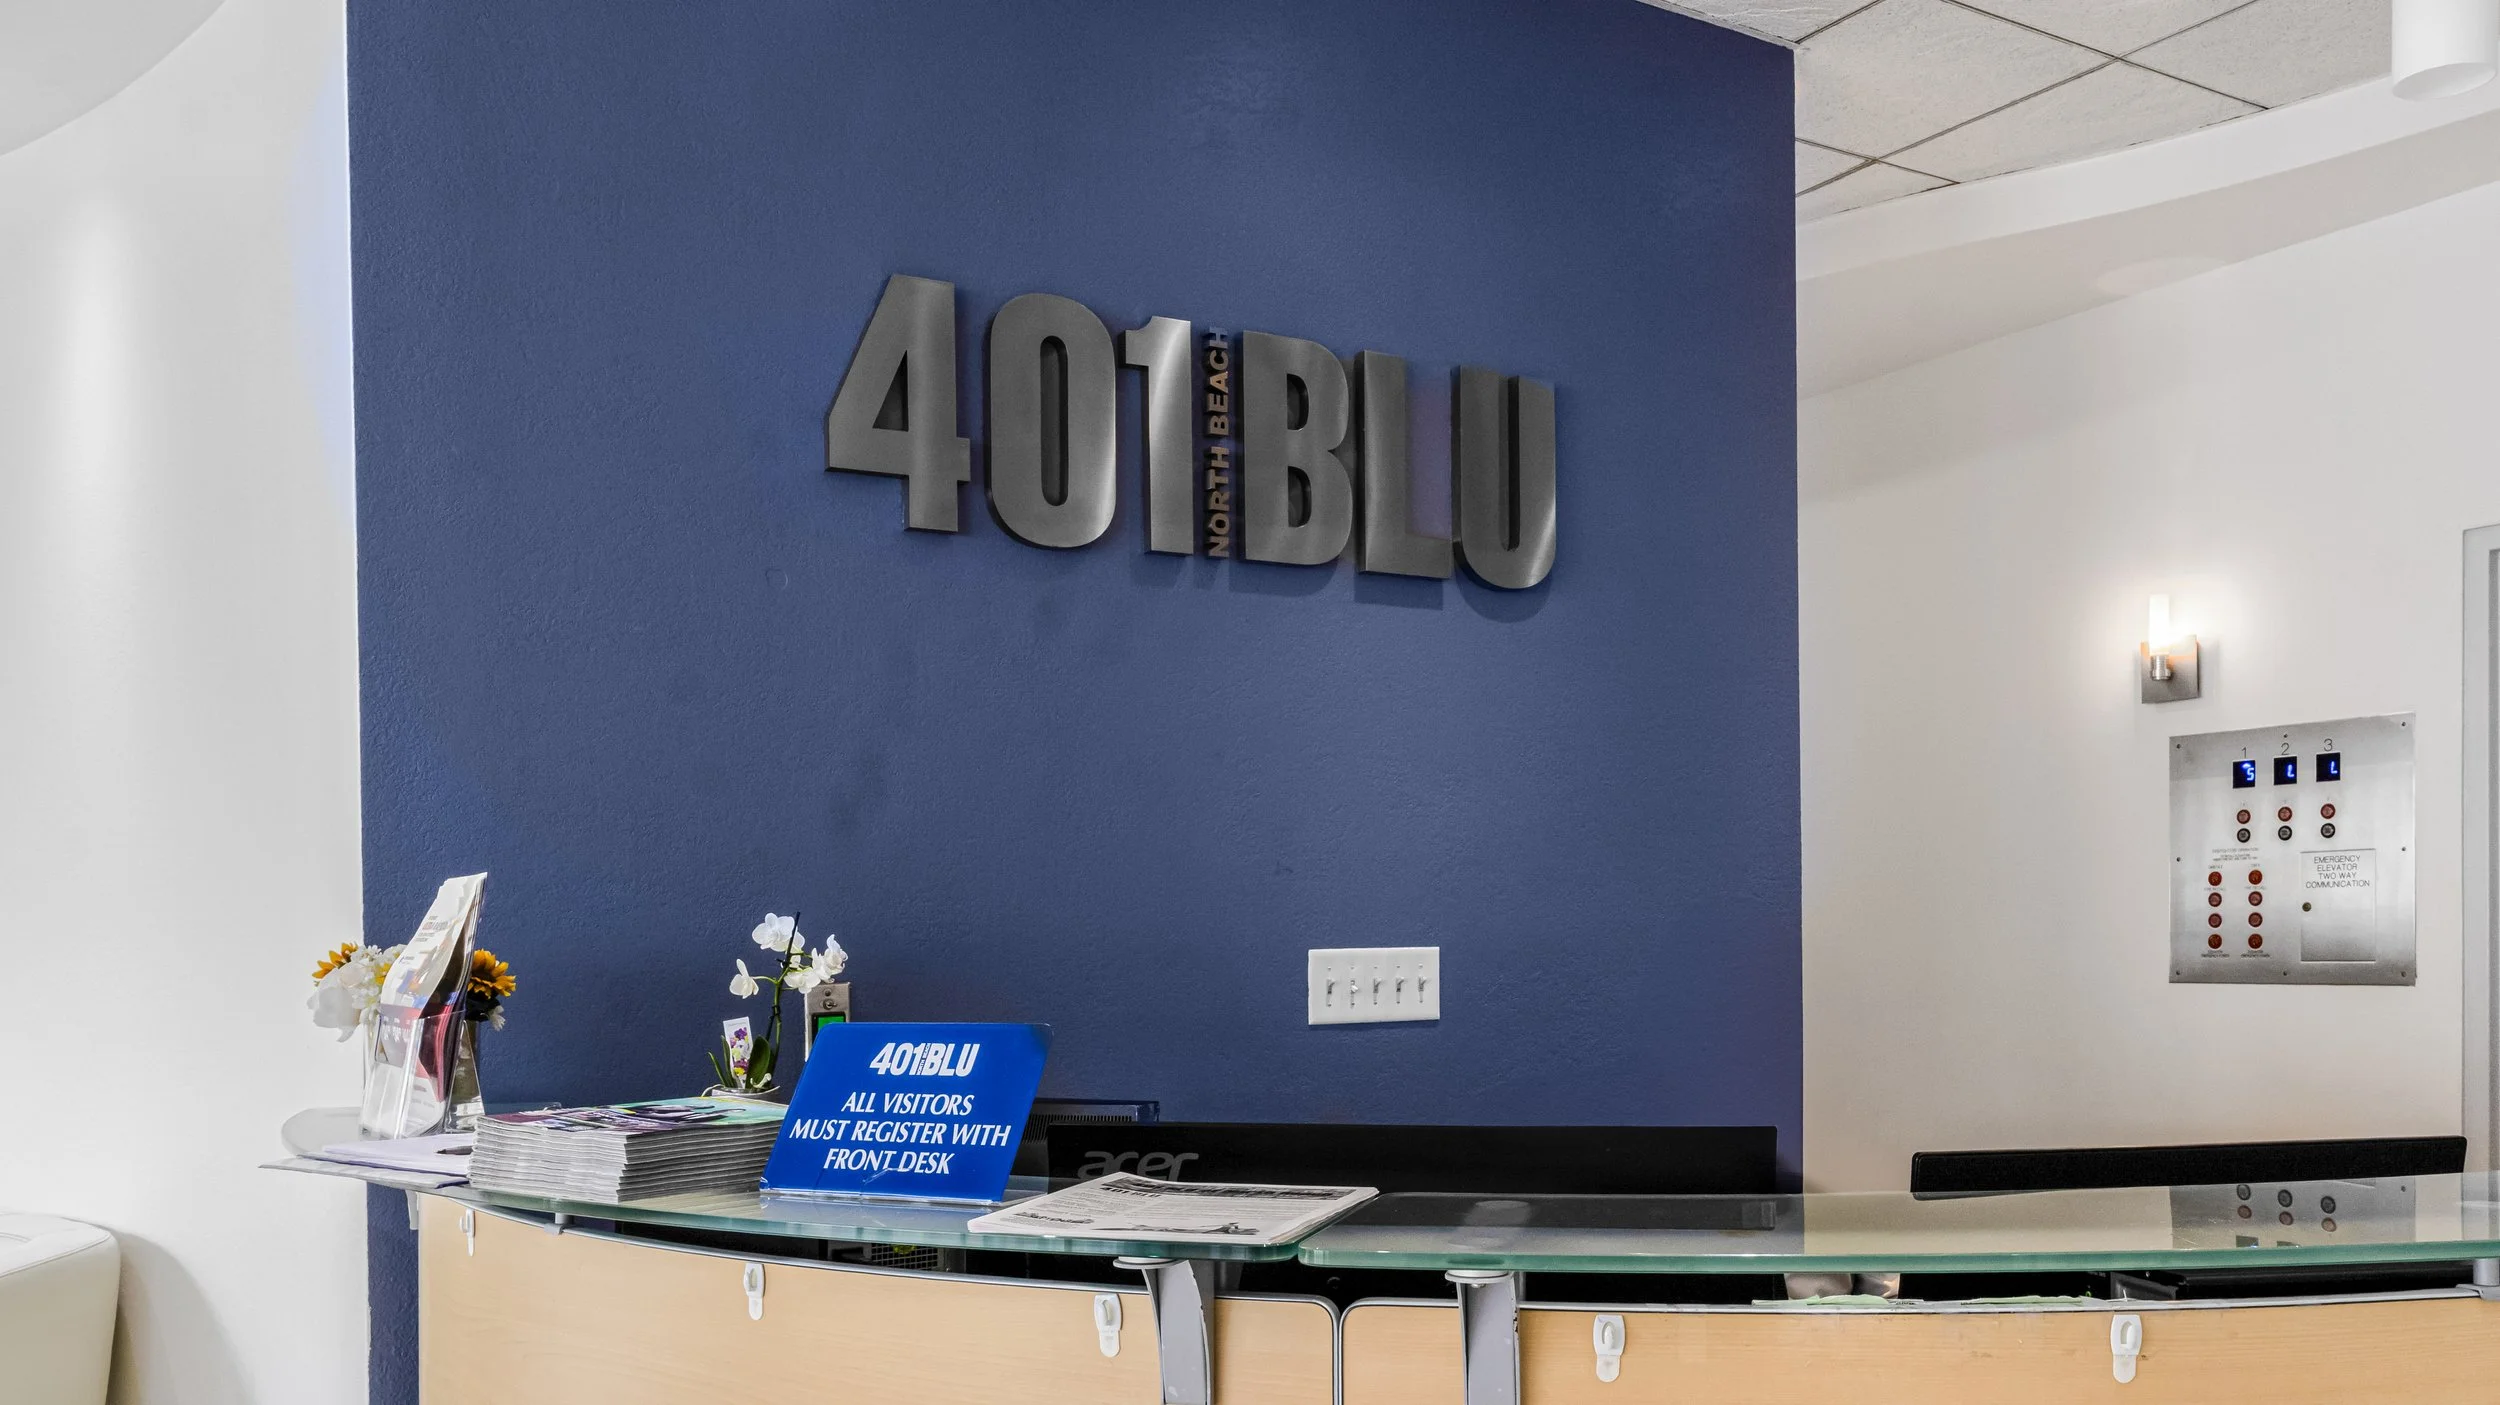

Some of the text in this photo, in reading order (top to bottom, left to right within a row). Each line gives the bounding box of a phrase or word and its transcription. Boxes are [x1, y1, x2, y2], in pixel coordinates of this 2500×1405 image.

[1206, 326, 1230, 558] NORTH BEACH
[2241, 738, 2334, 759] 1 2 3
[2287, 764, 2295, 778] L
[2330, 760, 2338, 774] L
[2313, 854, 2361, 864] EMERGENCY
[2316, 863, 2358, 872] ELEVATOR
[2305, 879, 2370, 889] COMMUNICATION
[2318, 871, 2357, 880] TWO WAY
[841, 1091, 975, 1116] ALL VISITORS
[789, 1118, 1012, 1147] MUST REGISTER WITH
[823, 1148, 956, 1175] FRONT DESK
[1077, 1150, 1200, 1182] acer
